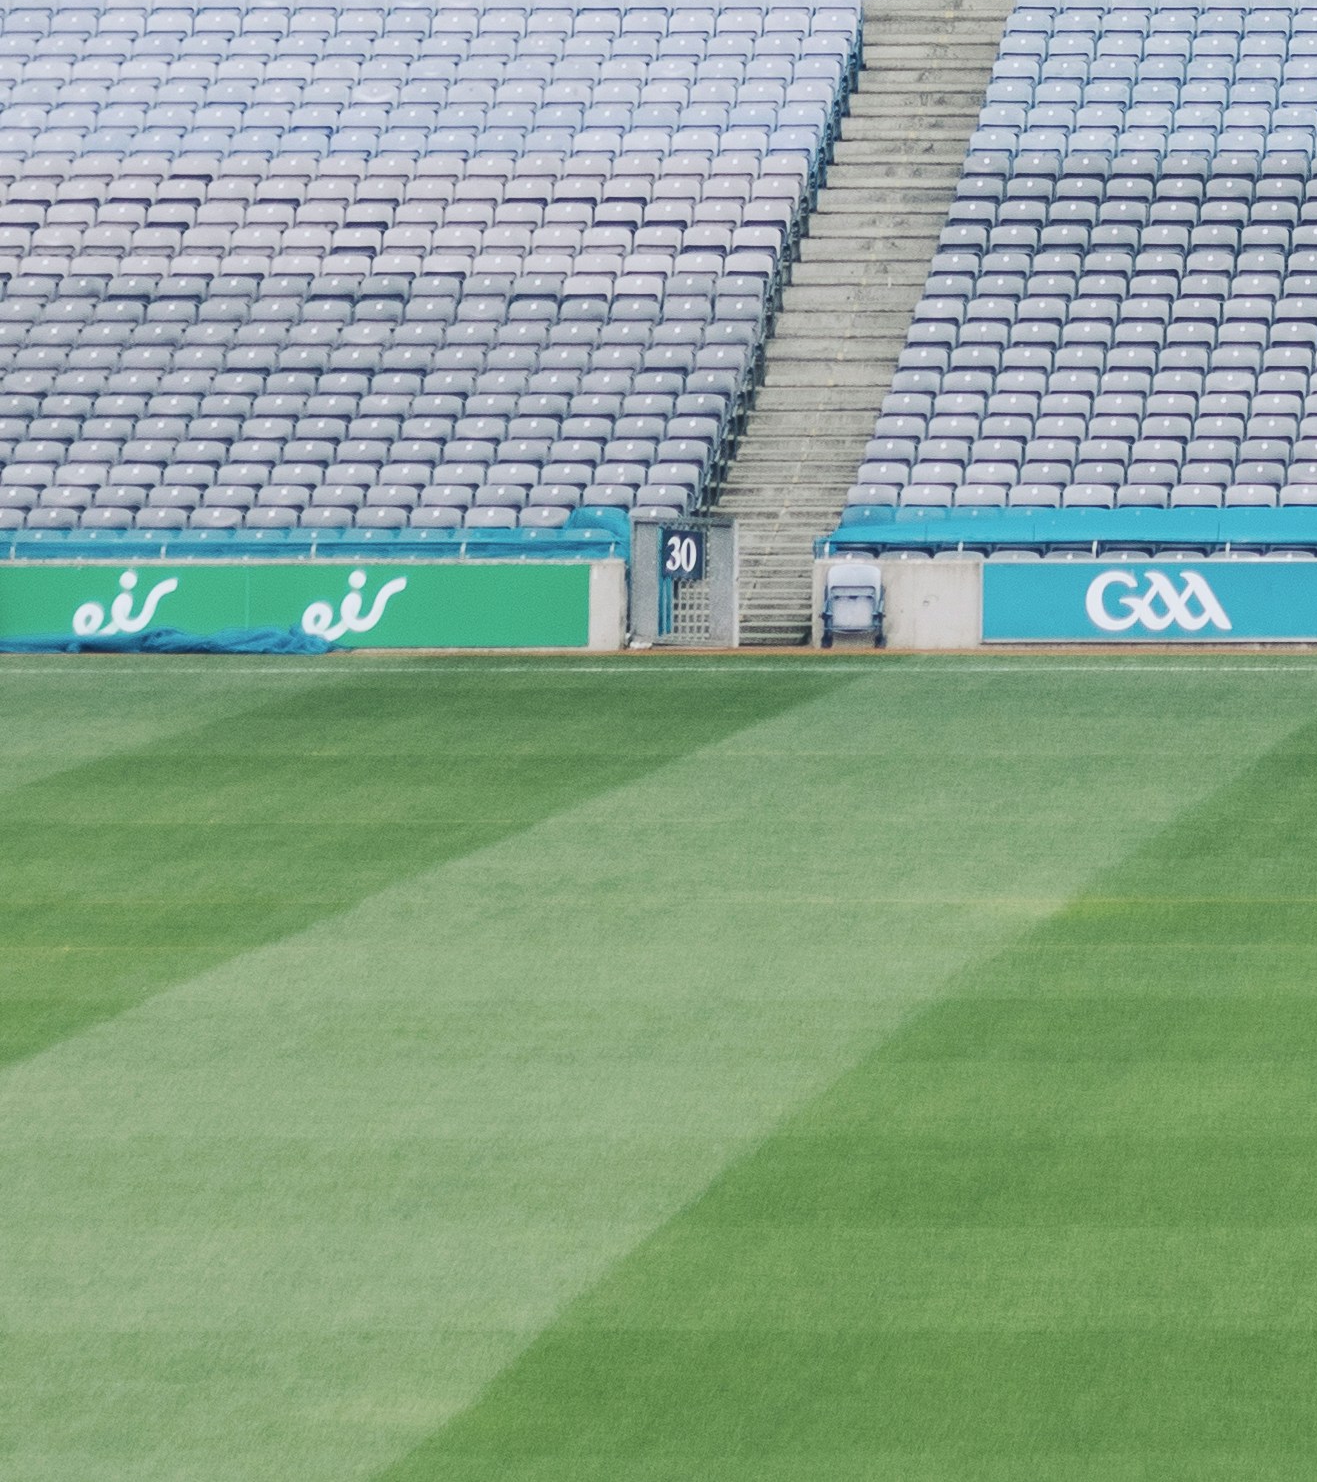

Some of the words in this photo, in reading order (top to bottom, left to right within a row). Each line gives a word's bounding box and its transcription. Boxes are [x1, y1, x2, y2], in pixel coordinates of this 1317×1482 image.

[666, 535, 698, 572] 30
[301, 569, 408, 642] eir
[1085, 570, 1233, 632] GAA
